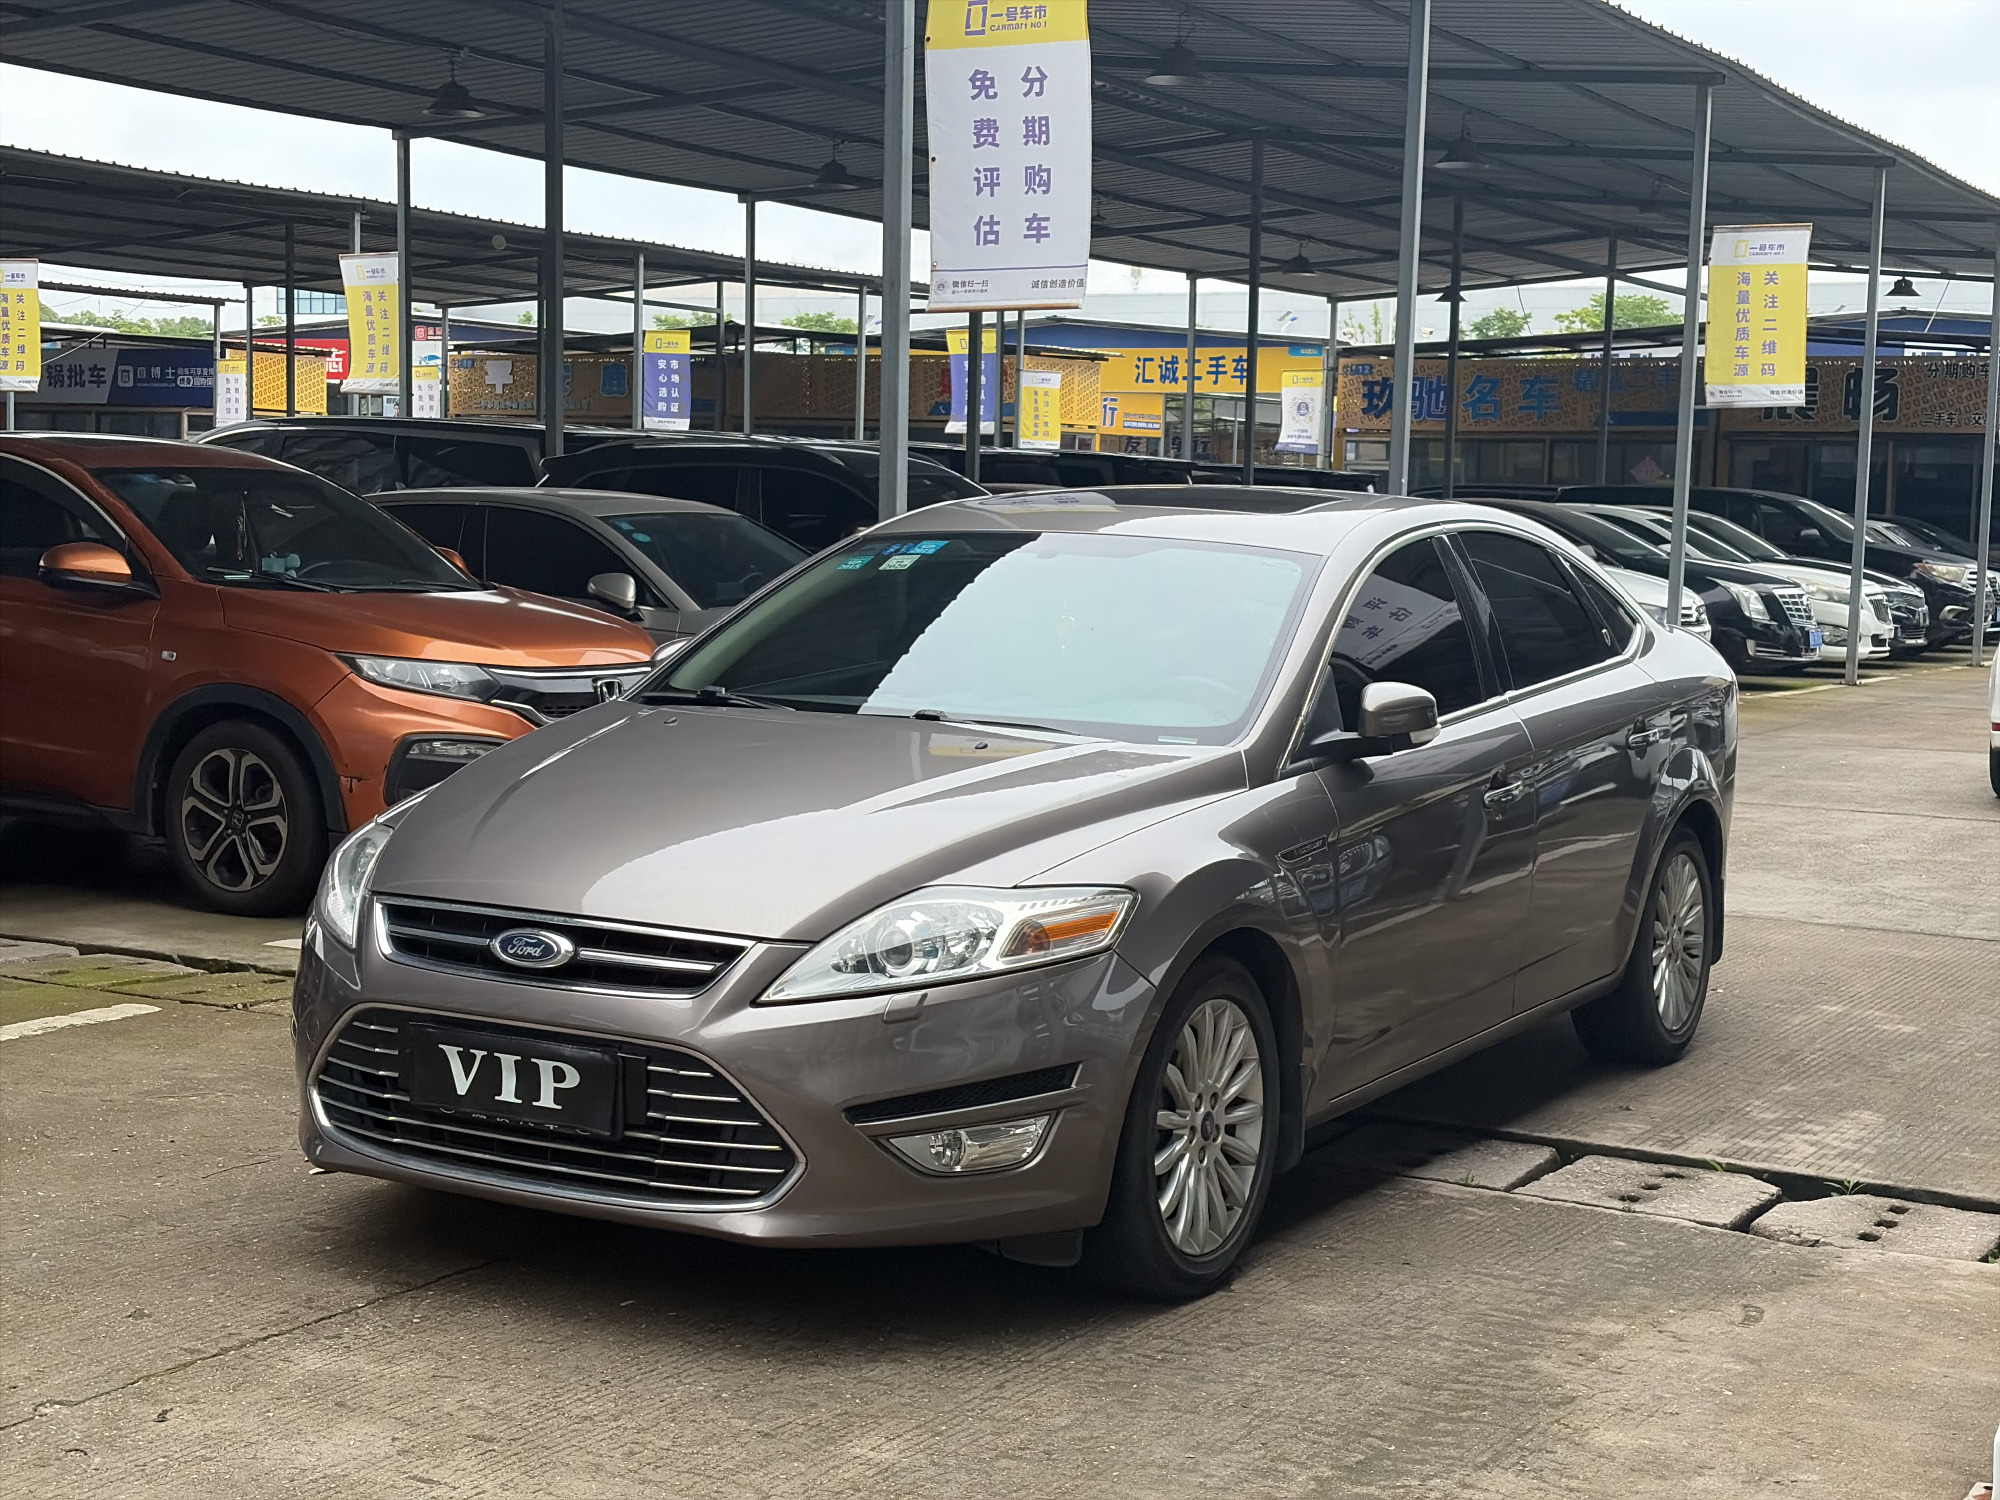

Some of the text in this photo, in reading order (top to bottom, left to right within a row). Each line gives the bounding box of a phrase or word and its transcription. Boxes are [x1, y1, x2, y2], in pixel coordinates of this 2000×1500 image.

[990, 4, 1047, 21] 一号车市
[968, 69, 1000, 246] 免费评估
[1020, 66, 1052, 244] 分期购车
[1031, 278, 1085, 289] 诚信创造价值
[16, 294, 26, 372] 关注二维码
[363, 290, 375, 374] 海量优质车源
[377, 290, 390, 374] 关注二维码
[1733, 272, 1750, 377] 海量优质车源
[1761, 271, 1779, 377] 关注二维码
[657, 359, 668, 412] 安心选购
[670, 359, 680, 413] 市场认证
[1134, 354, 1247, 386] 汇诚二手车
[1925, 362, 1990, 380] 分期购车
[507, 936, 546, 957] Ford
[438, 1043, 581, 1110] VIP
